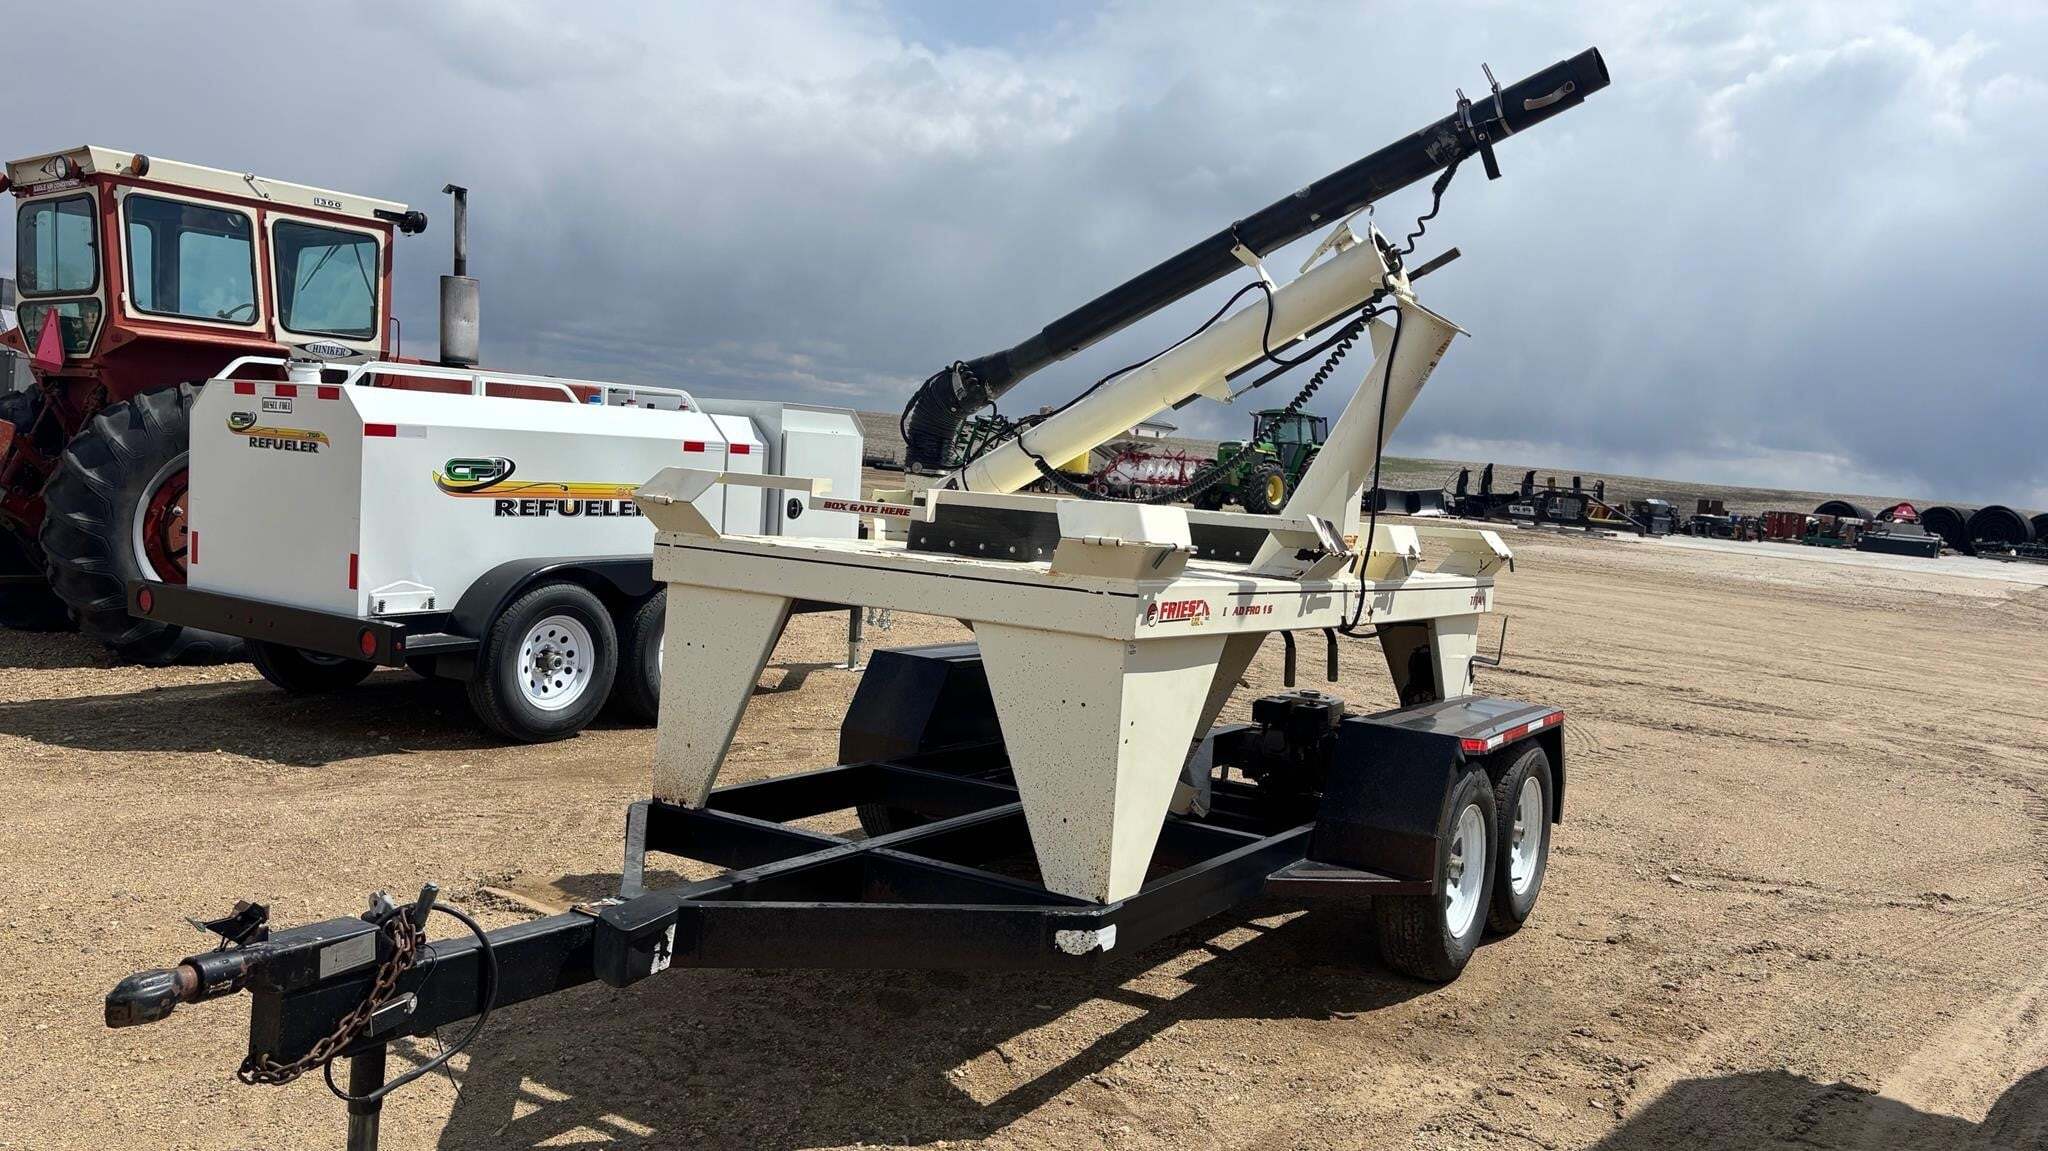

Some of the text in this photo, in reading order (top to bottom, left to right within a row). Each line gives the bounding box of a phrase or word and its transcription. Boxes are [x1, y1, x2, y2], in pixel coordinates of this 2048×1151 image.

[312, 345, 346, 357] HINIKER
[249, 437, 320, 453] REFUELER
[823, 501, 912, 516] BOX GATE HERE
